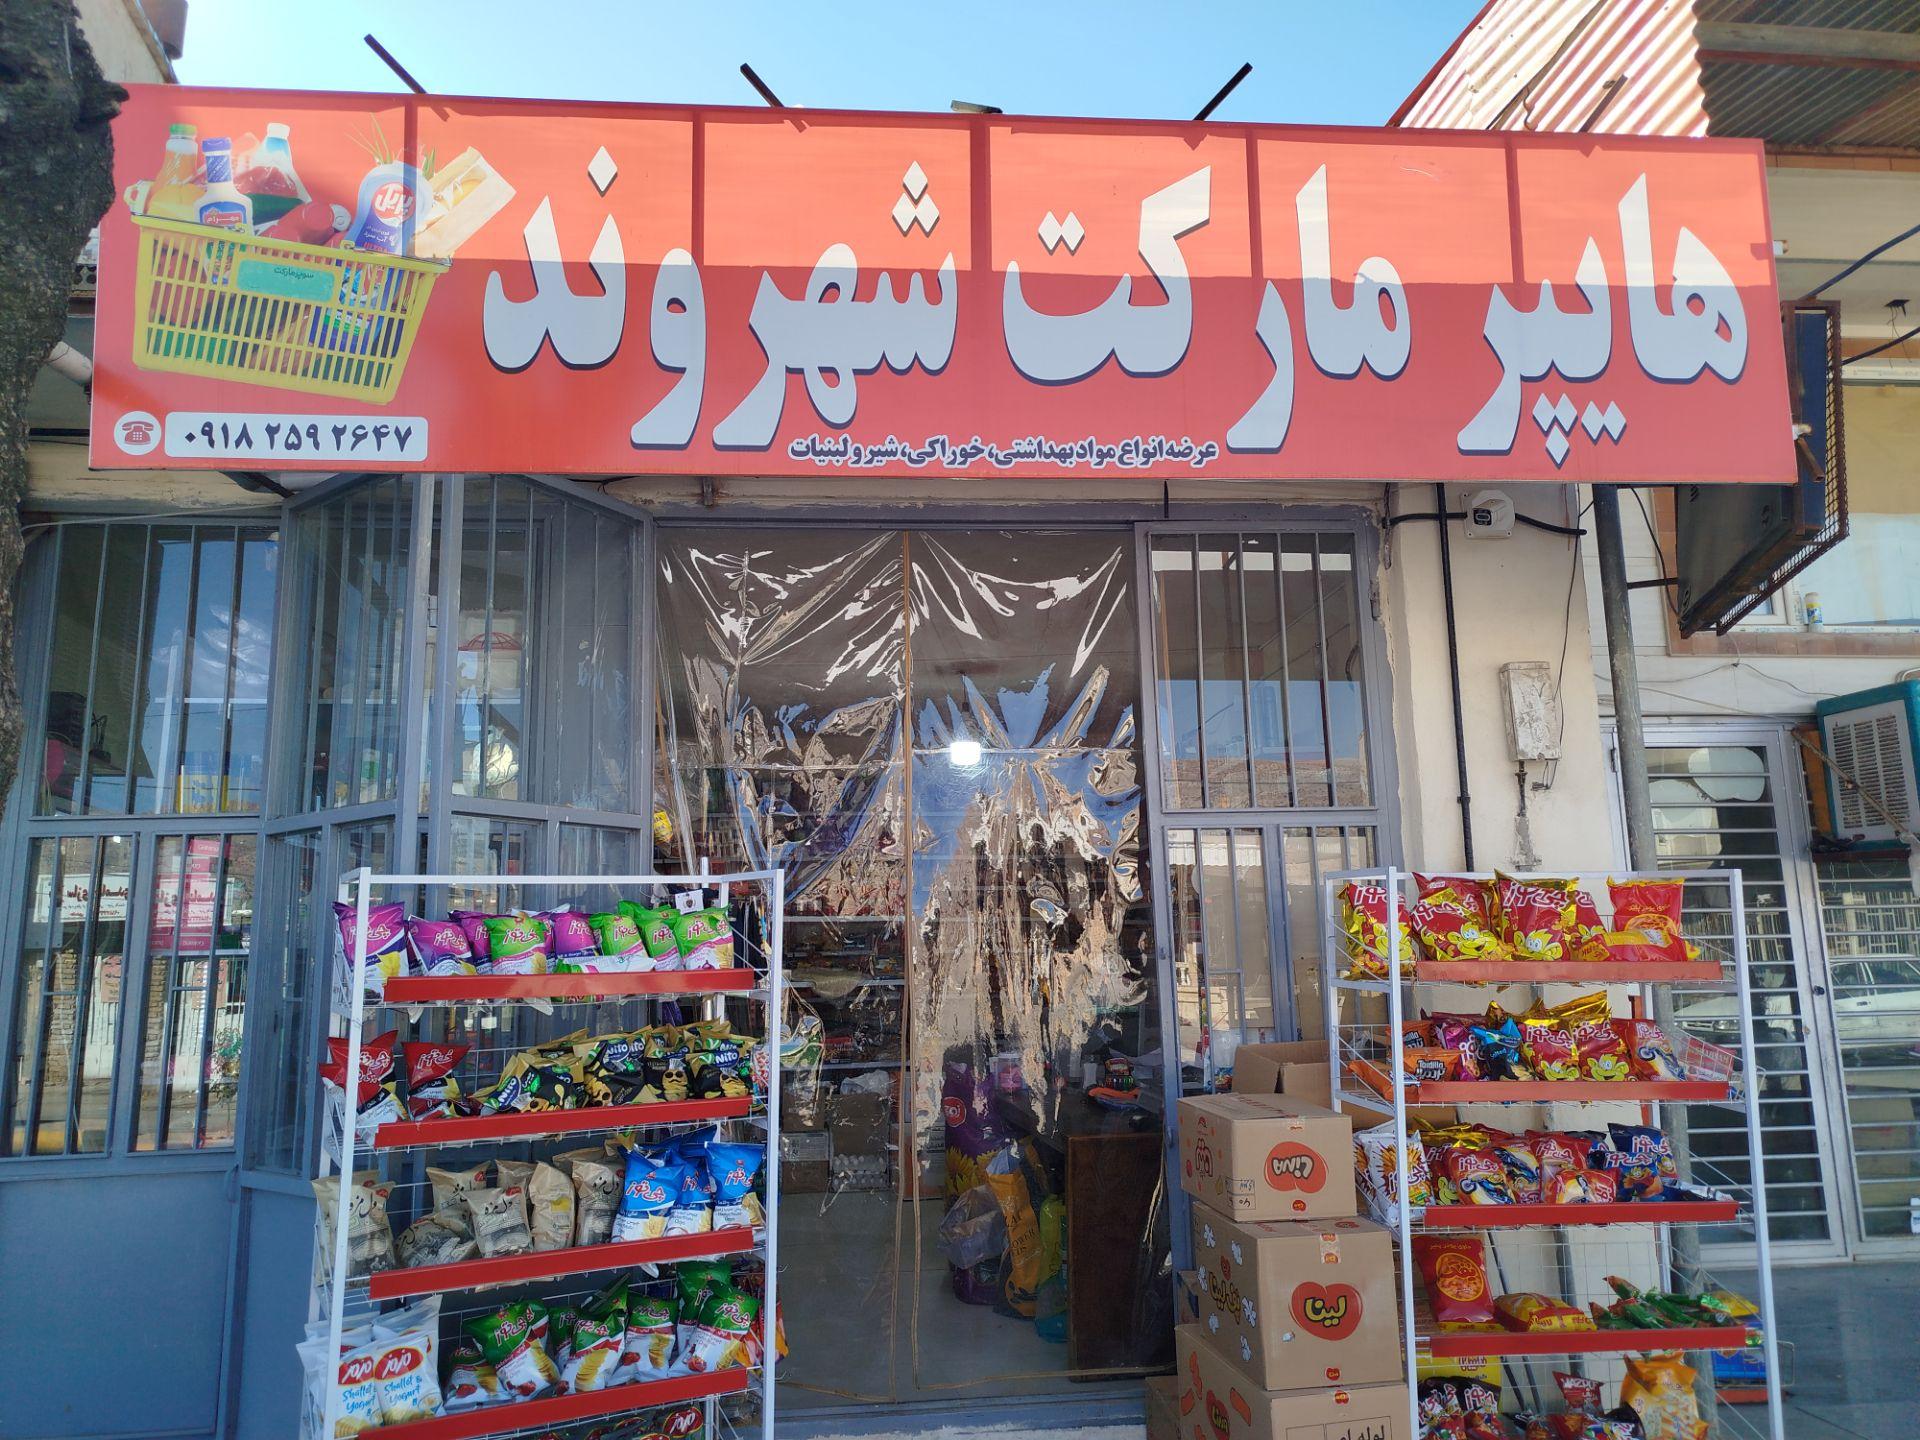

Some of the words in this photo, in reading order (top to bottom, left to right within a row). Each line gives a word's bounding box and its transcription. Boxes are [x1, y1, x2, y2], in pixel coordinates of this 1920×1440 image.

[273, 265, 315, 280] سوپرمارکت
[483, 145, 959, 451] شهروند
[1002, 163, 1412, 454] مارکت
[1456, 171, 1749, 469] هایپر
[185, 421, 253, 449] ۰۹۱۸
[264, 422, 321, 450] ۲۵۹
[330, 423, 412, 452] ۲۶۴۷
[787, 432, 850, 467] لبنیات
[863, 434, 901, 468] شیر
[1075, 436, 1117, 468] مواد
[1117, 436, 1165, 467] انواع
[1164, 437, 1218, 468] عرضه
[847, 443, 865, 467] و
[1304, 1295, 1348, 1328] لینا
